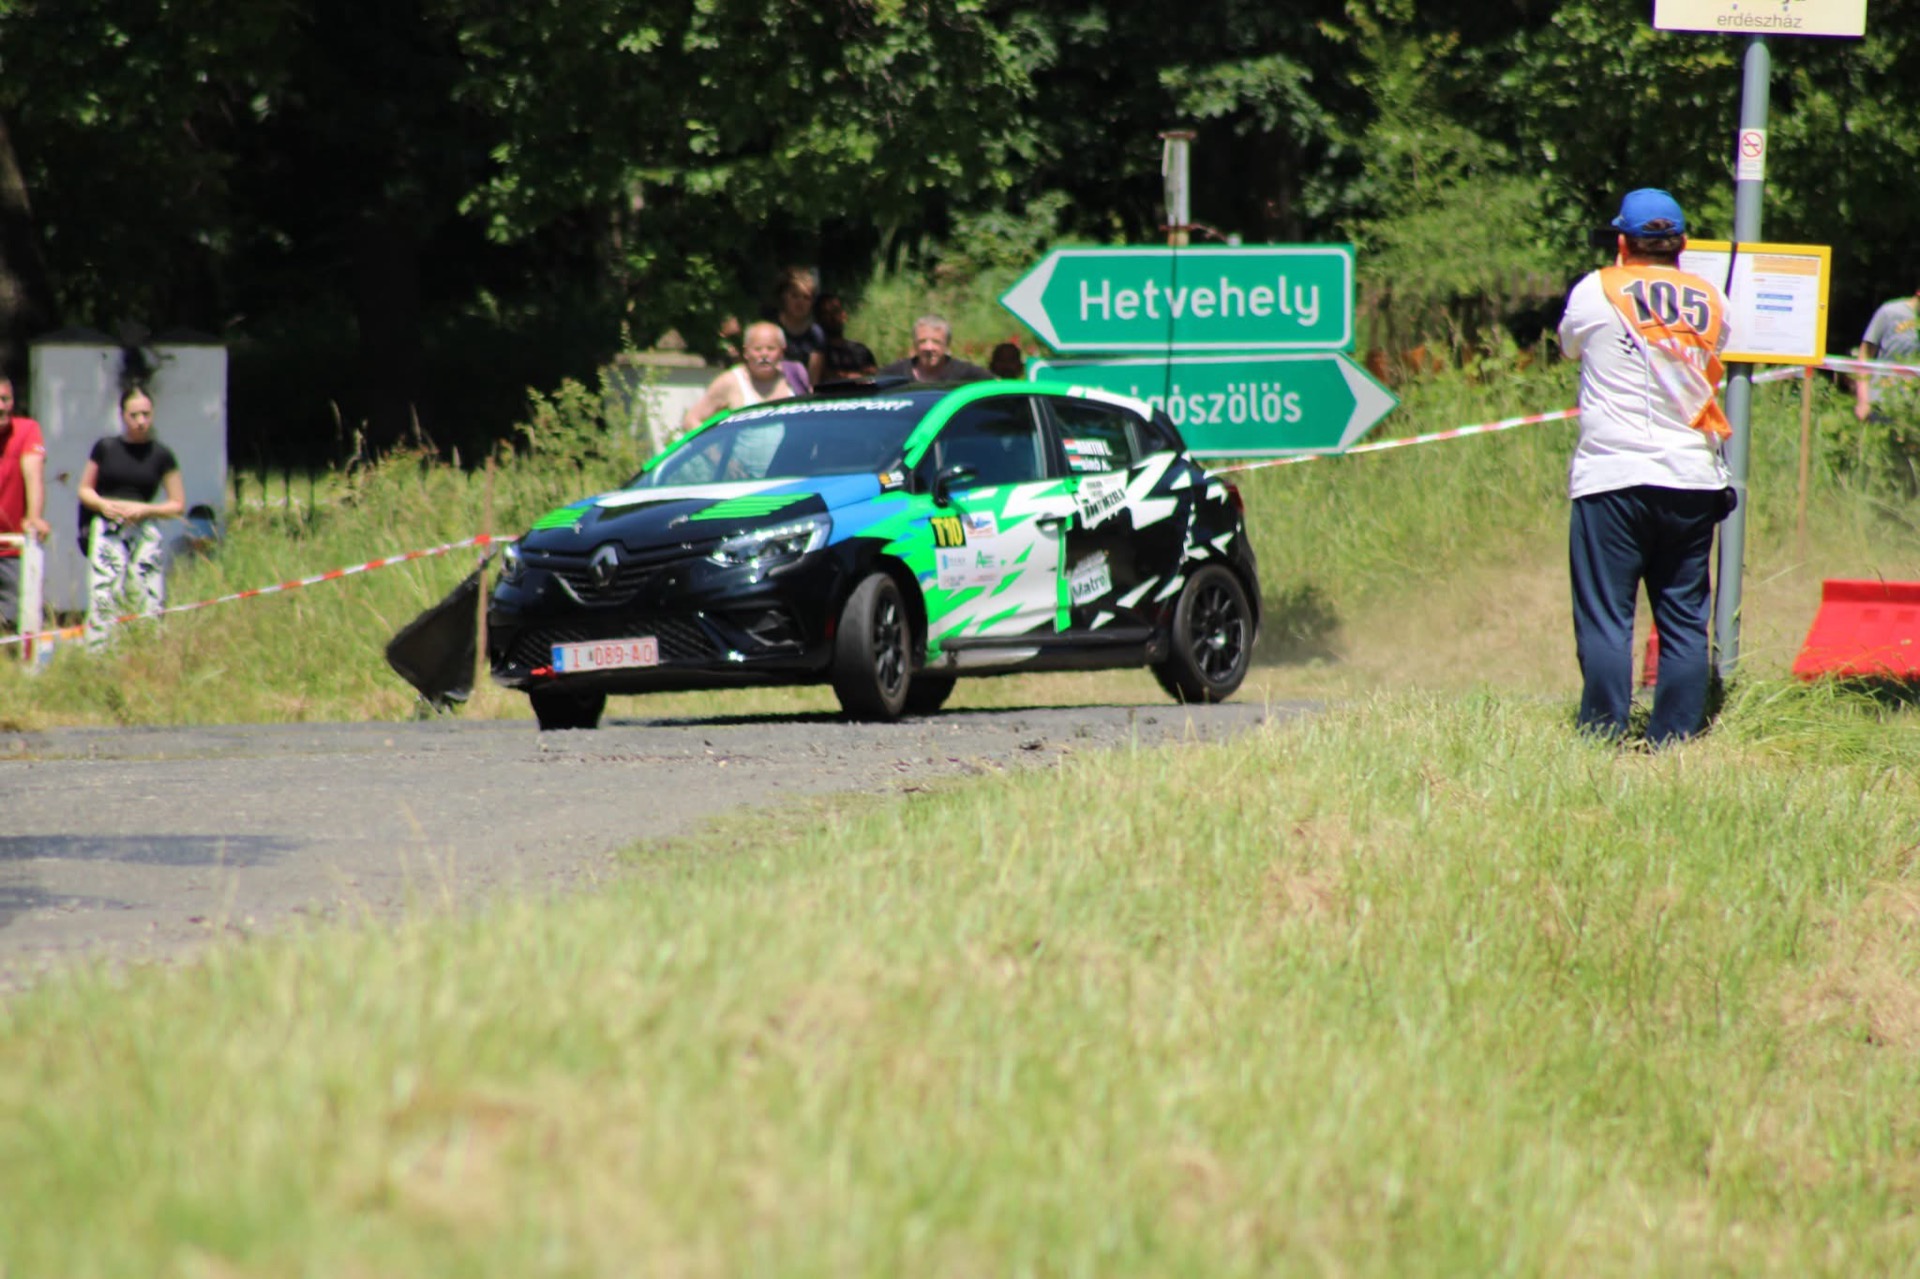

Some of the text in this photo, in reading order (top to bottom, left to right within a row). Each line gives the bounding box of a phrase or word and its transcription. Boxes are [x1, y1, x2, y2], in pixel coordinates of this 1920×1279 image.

[1716, 14, 1802, 29] erdészház
[1079, 276, 1319, 327] Hetvehely
[1620, 279, 1710, 336] 105
[930, 516, 963, 547] T10
